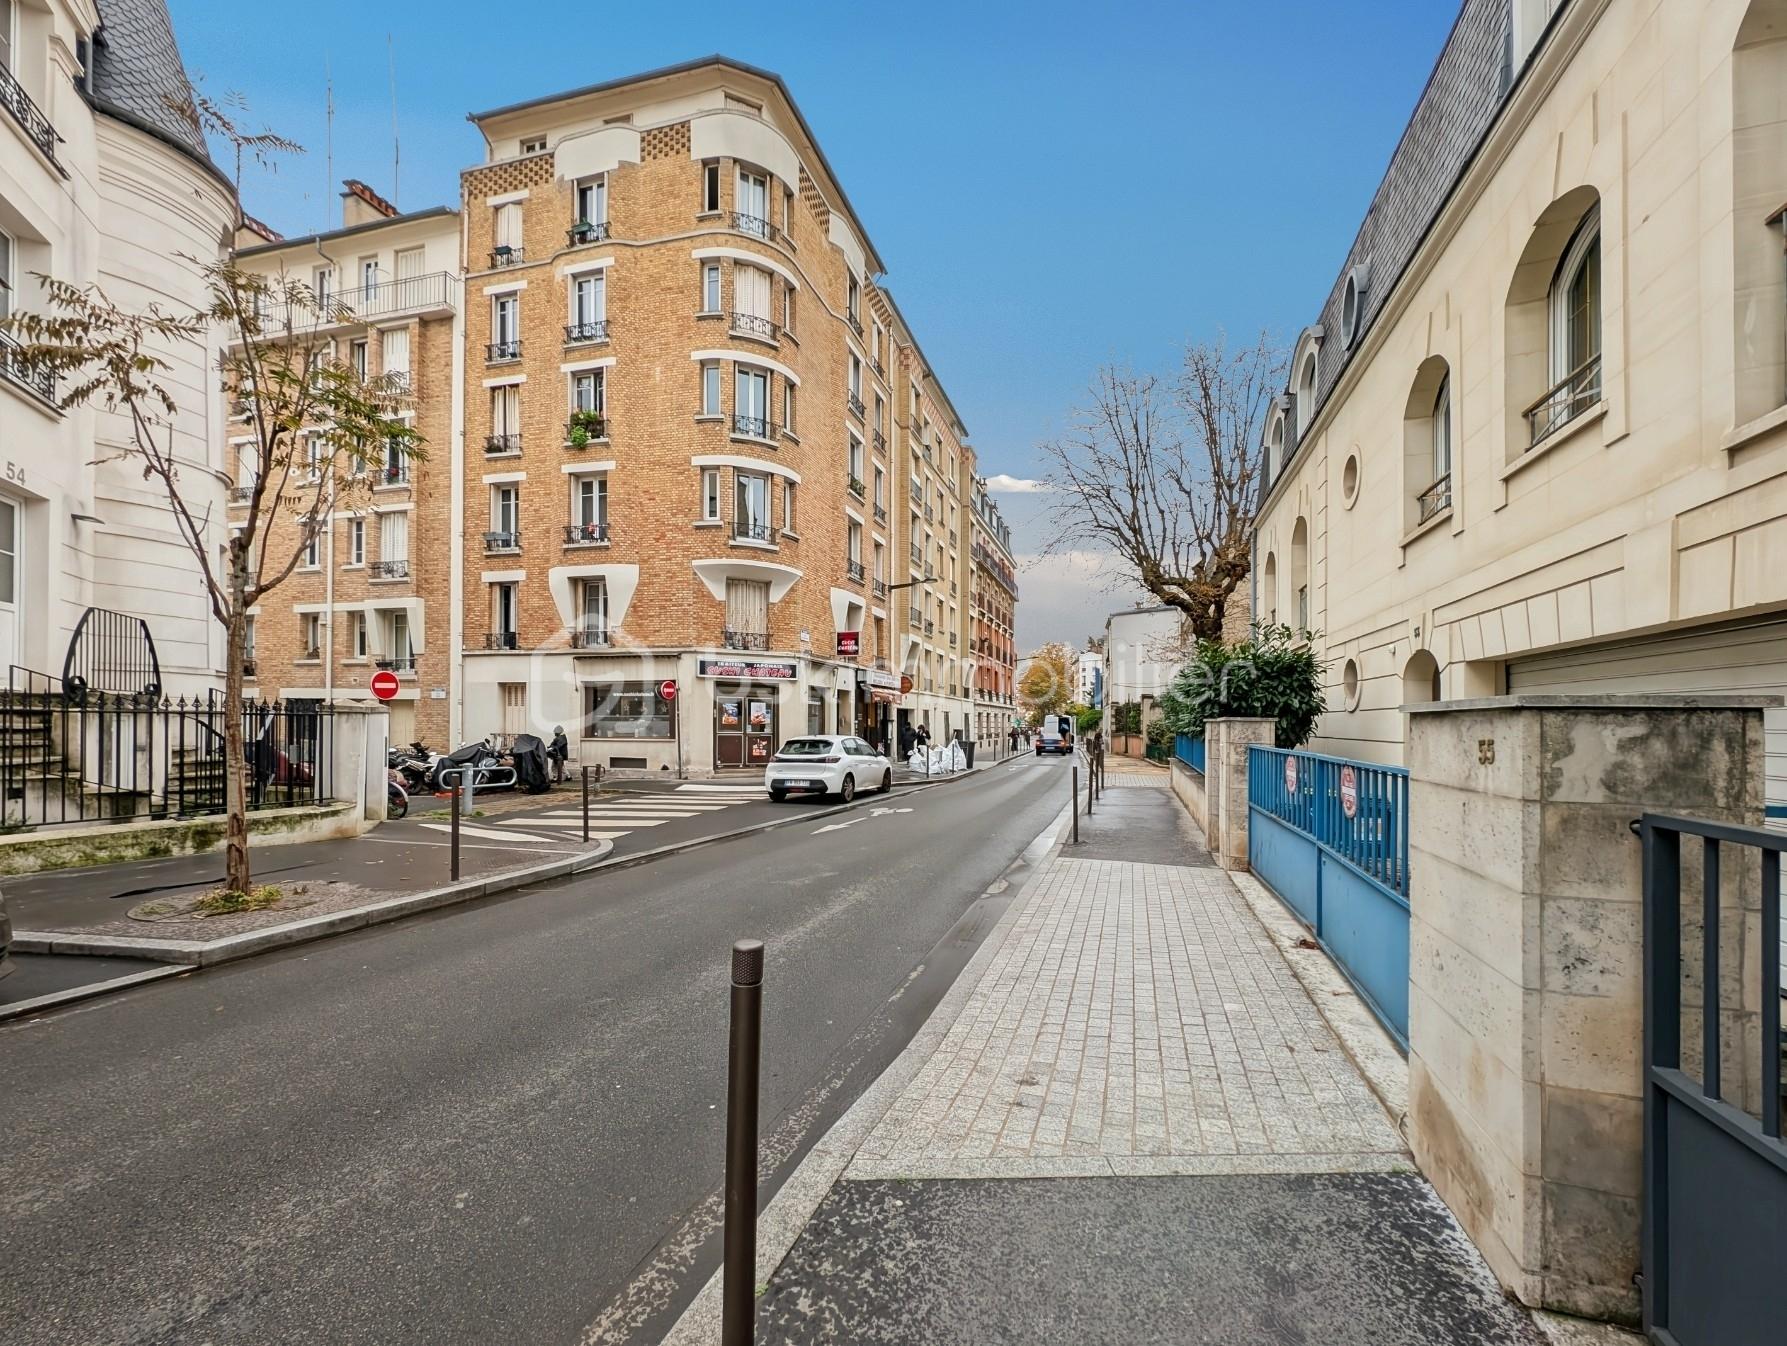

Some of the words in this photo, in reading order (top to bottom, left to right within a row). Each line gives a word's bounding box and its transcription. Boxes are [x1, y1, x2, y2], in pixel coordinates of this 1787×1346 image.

[6, 461, 26, 486] 54
[706, 666, 741, 676] SUSHI
[1478, 739, 1495, 765] 55
